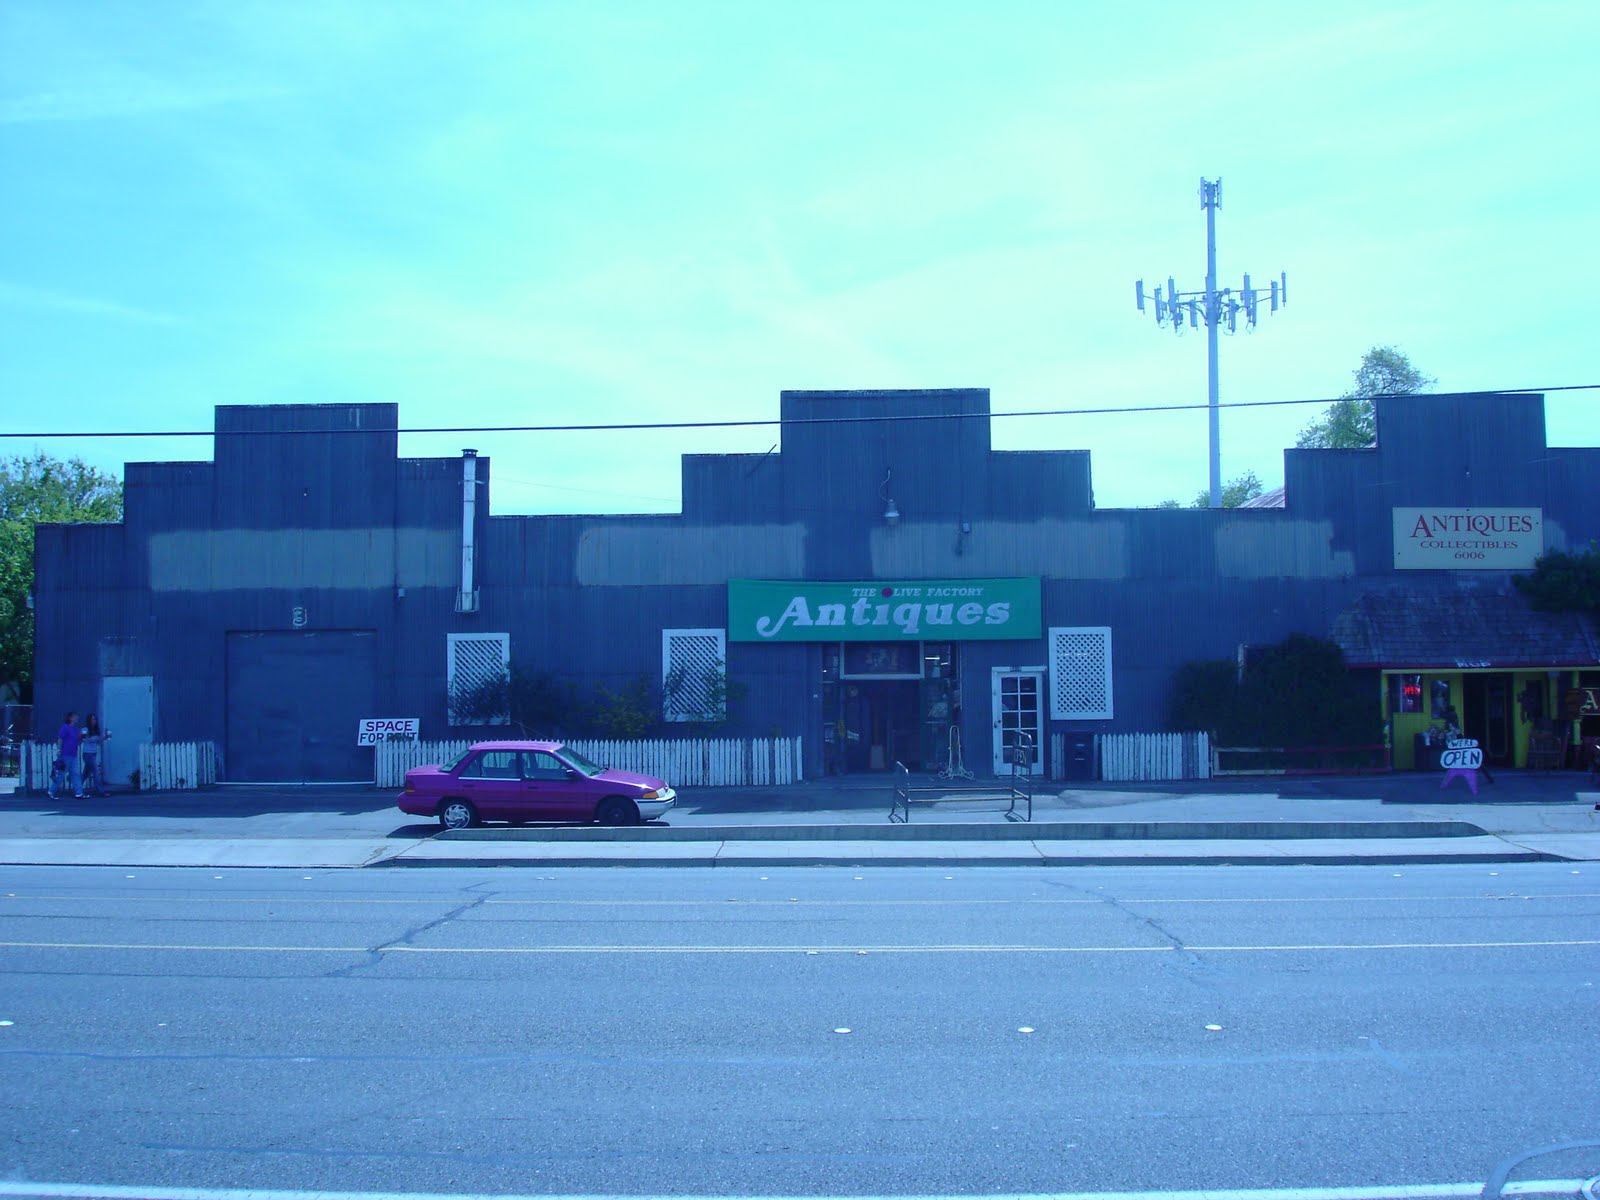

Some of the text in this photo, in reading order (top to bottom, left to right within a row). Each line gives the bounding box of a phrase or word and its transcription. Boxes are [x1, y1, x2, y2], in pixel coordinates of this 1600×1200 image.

[1409, 514, 1533, 538] ANTIQUES
[1420, 541, 1518, 549] COLLECTIBLES
[1454, 551, 1485, 560] 6006
[852, 587, 877, 597] THE
[927, 587, 984, 597] FACTORY
[756, 596, 1011, 638] Antiques
[366, 720, 413, 731] SPACE
[360, 732, 385, 743] FOR
[1443, 750, 1480, 766] OPEN
